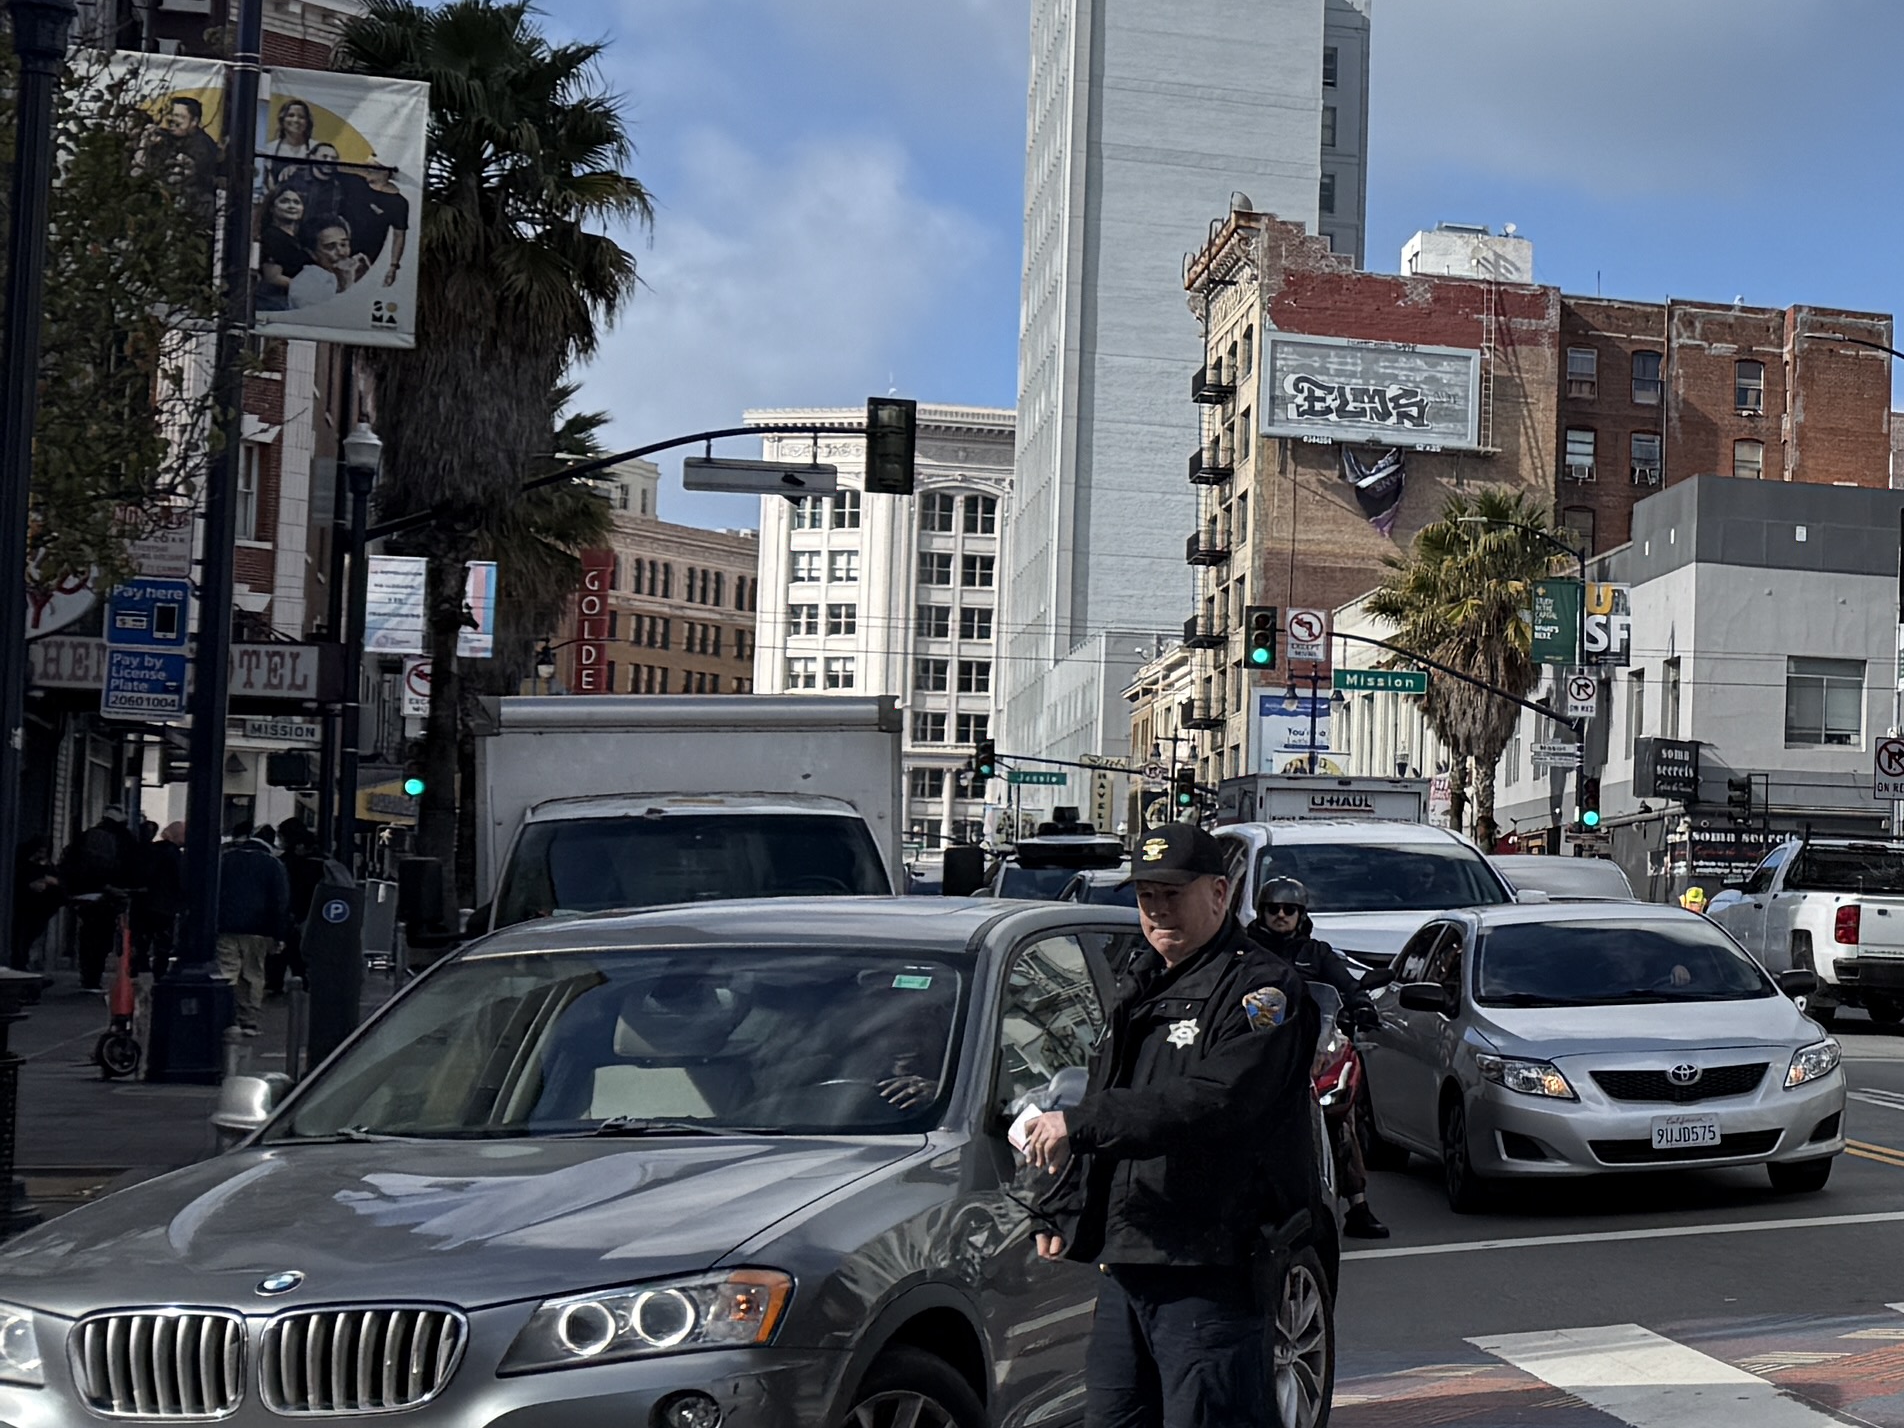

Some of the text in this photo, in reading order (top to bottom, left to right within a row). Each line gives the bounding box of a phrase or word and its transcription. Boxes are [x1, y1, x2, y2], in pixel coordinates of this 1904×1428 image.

[113, 584, 184, 600] Pay here
[1586, 615, 1628, 653] SF
[112, 653, 163, 669] Pay by
[111, 665, 167, 681] License
[1345, 674, 1415, 688] Mission
[110, 678, 149, 692] Plate
[110, 693, 177, 709] 20601004
[249, 722, 317, 739] MISSION
[1656, 764, 1695, 778] secrets
[1877, 782, 1890, 793] ON
[1656, 1124, 1716, 1145] 9UJD575
